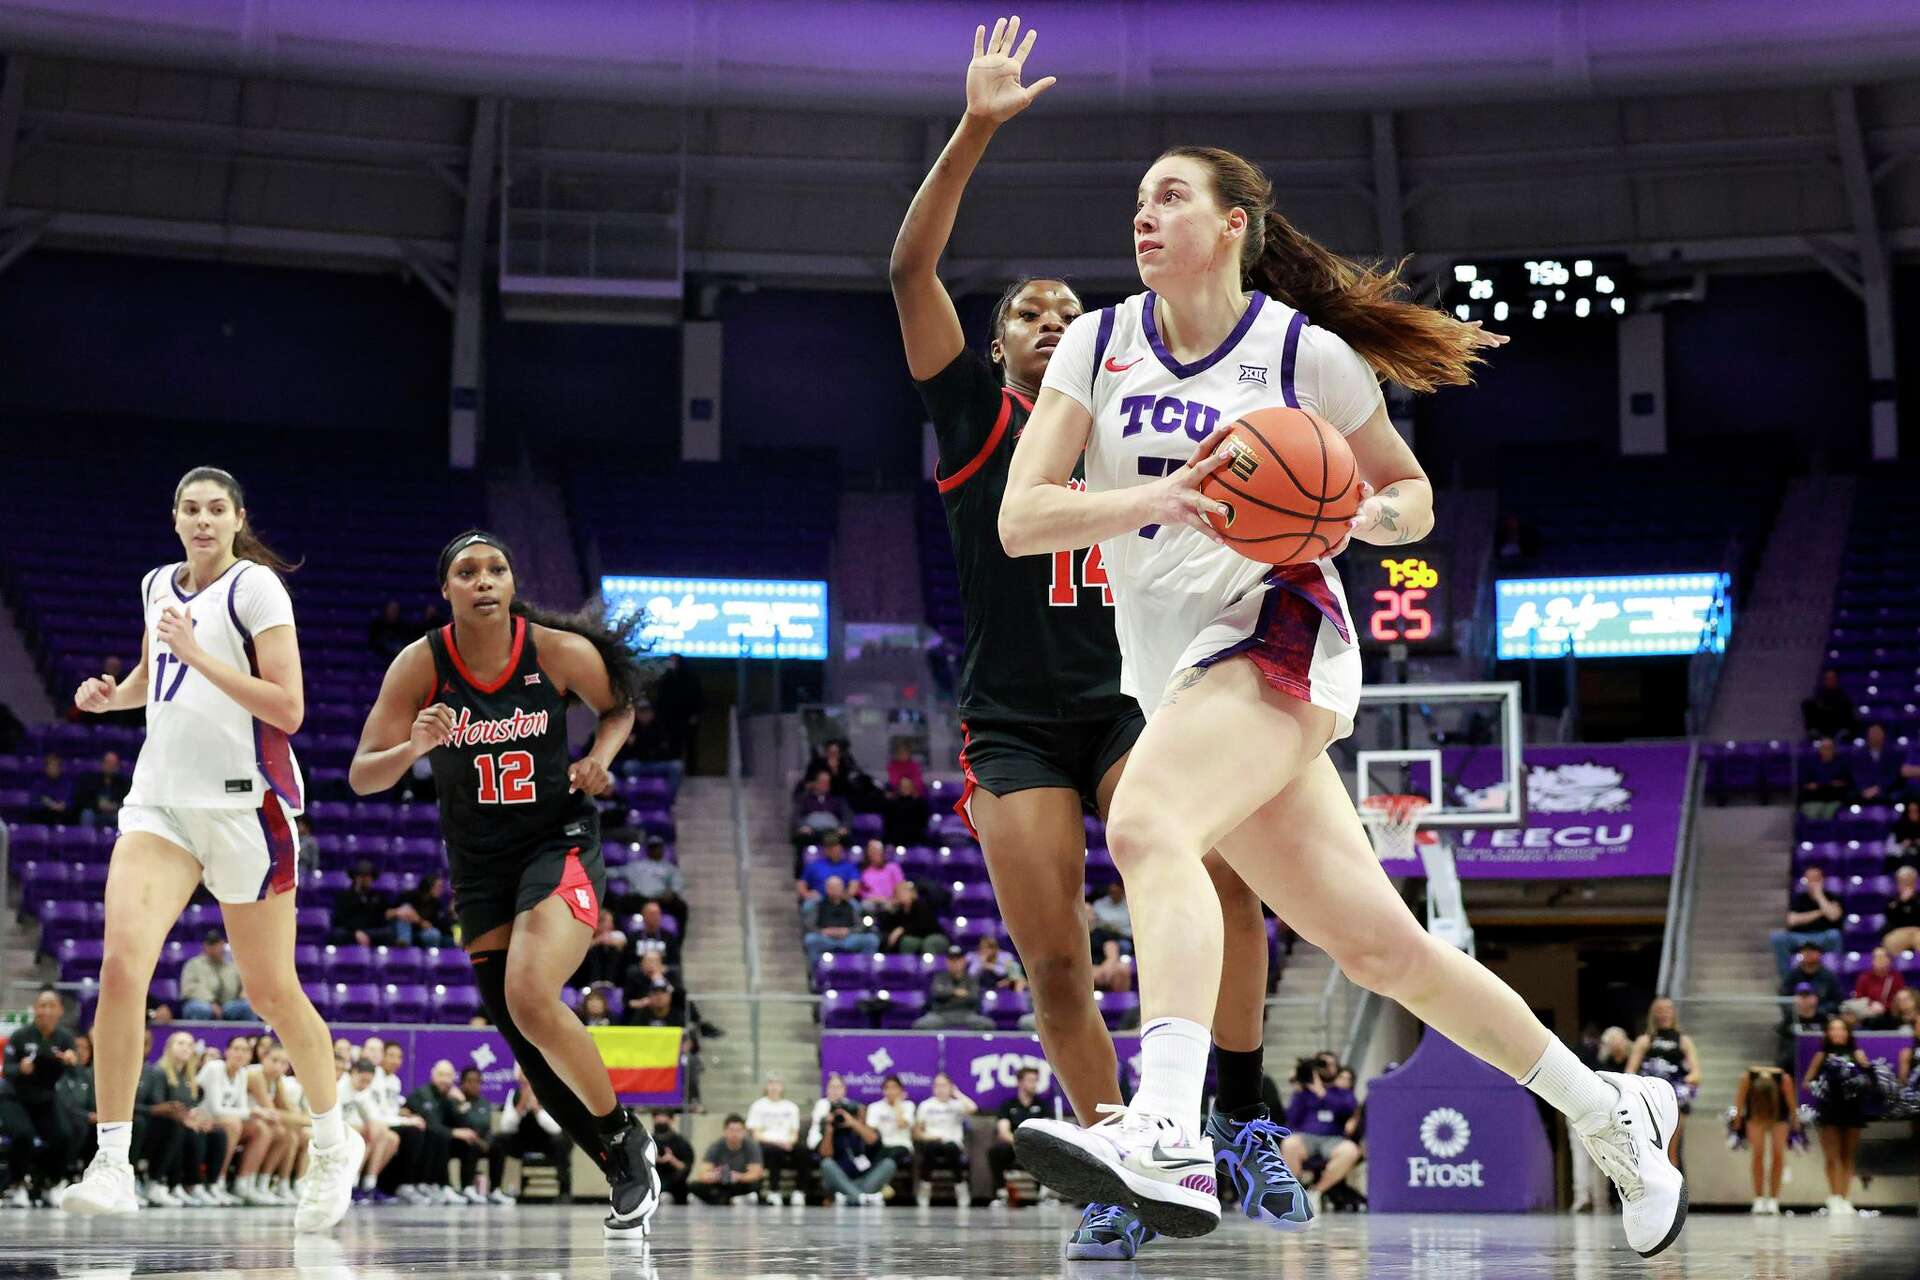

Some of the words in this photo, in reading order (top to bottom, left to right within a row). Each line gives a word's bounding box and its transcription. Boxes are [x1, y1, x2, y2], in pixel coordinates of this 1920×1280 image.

[1120, 394, 1221, 443] TCU
[1381, 559, 1438, 588] 7:56
[1371, 589, 1432, 640] 25
[154, 653, 189, 702] 17
[443, 706, 549, 748] Houston
[474, 750, 536, 804] 12
[1490, 823, 1634, 847] EECU
[1407, 1156, 1485, 1187] Frost
